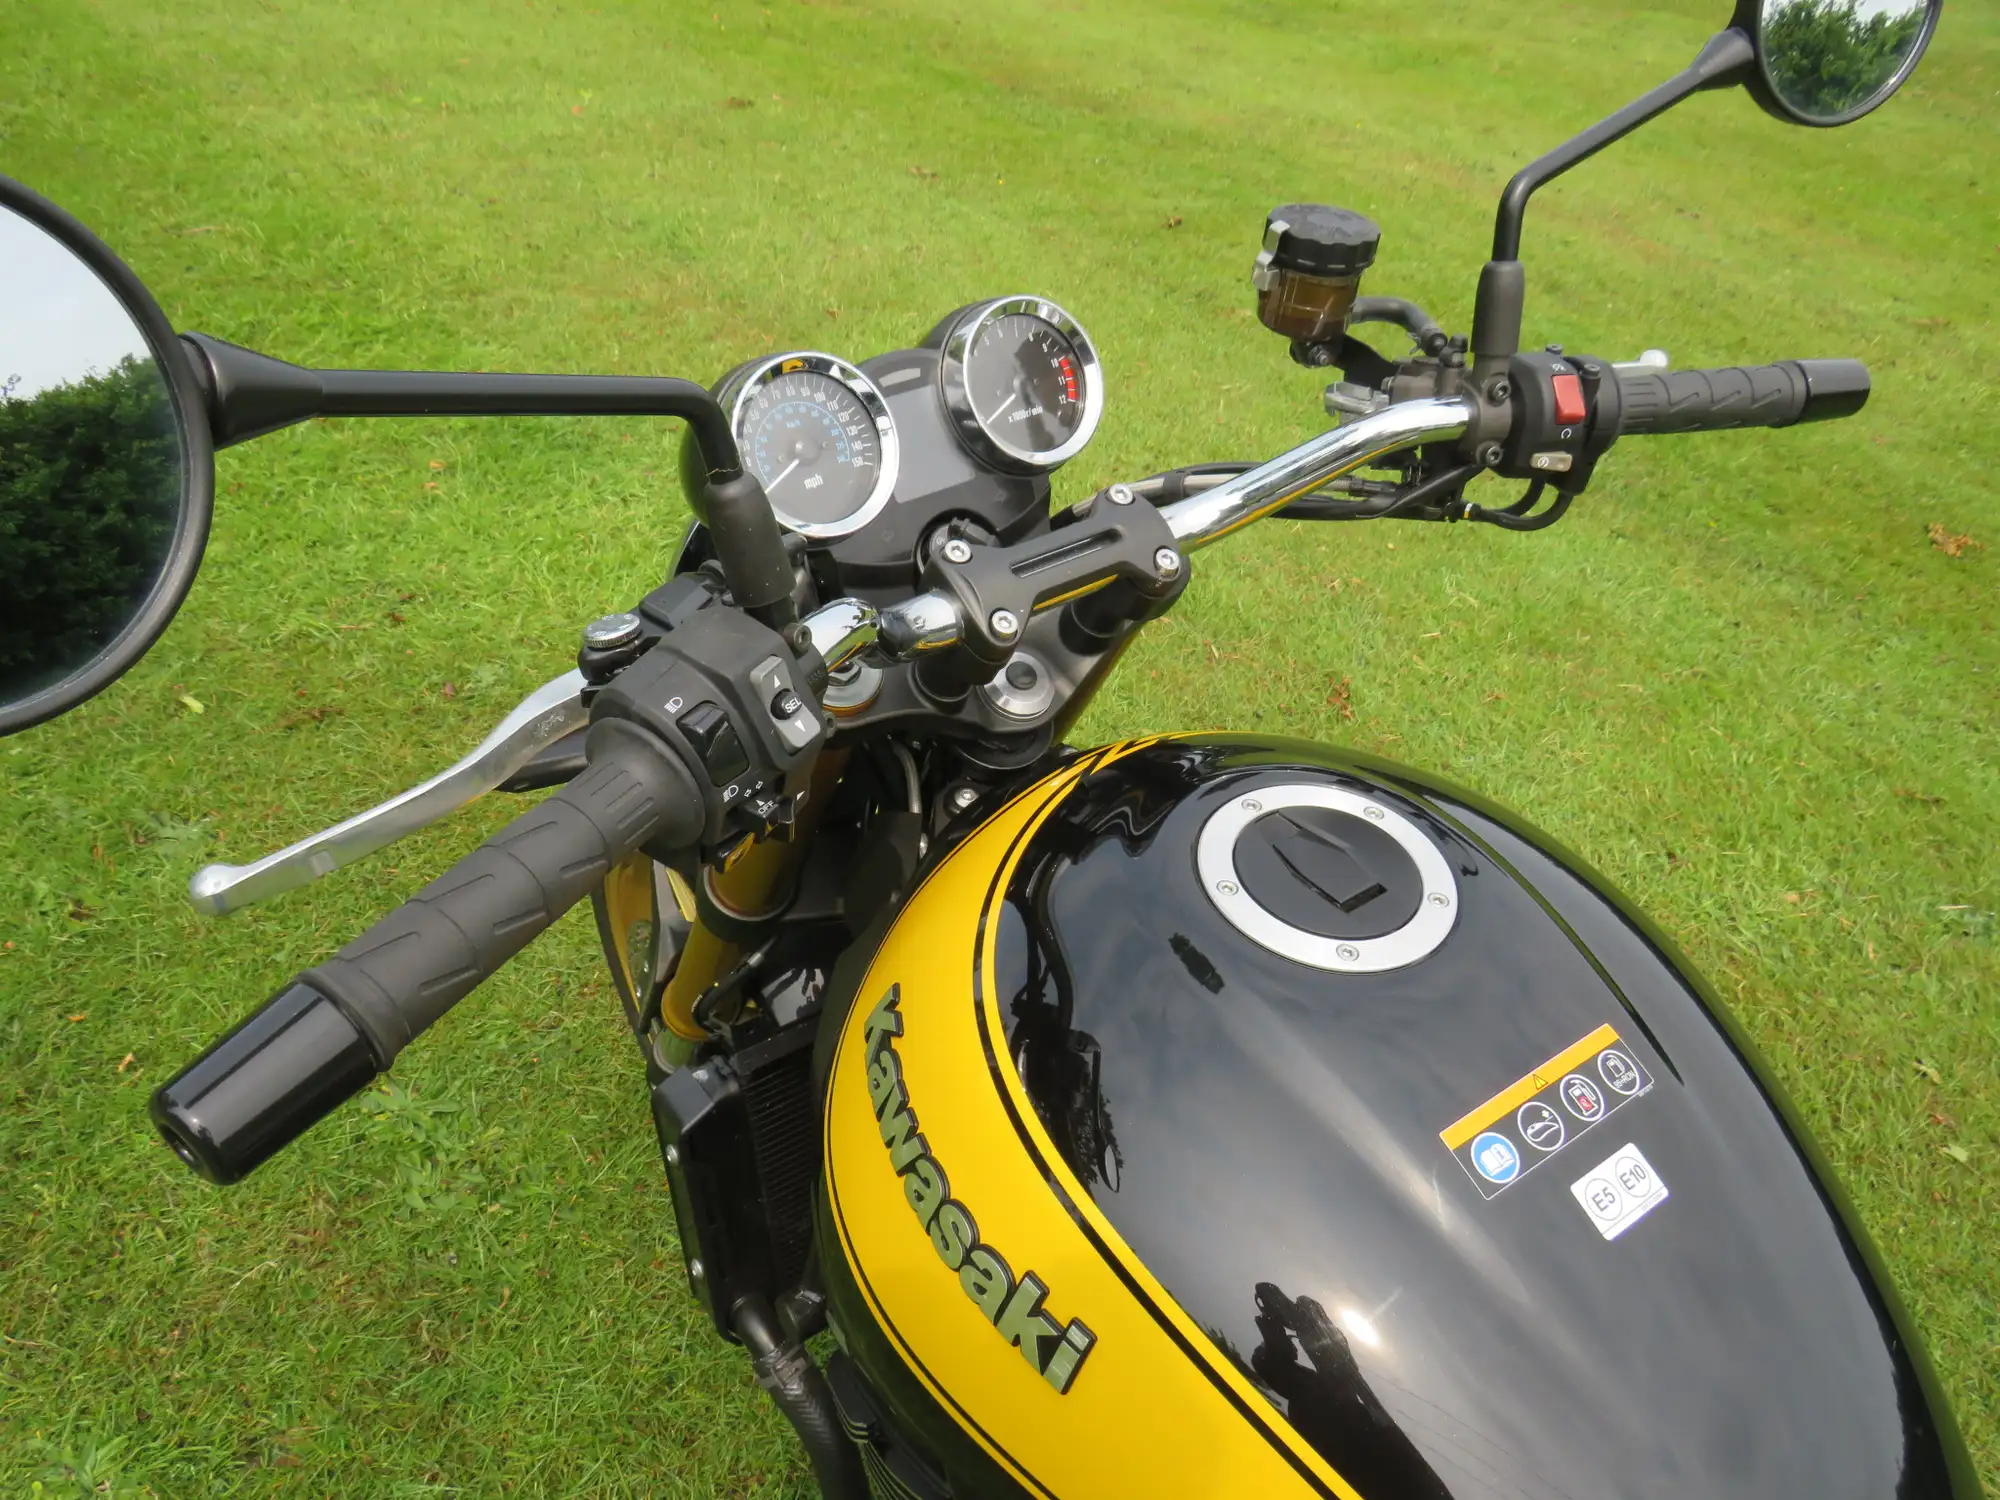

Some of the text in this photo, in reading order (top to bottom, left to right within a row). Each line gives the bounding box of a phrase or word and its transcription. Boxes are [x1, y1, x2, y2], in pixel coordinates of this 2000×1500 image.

[1050, 358, 1059, 369] 10
[1058, 375, 1066, 385] 11
[800, 386, 810, 397] 90
[813, 391, 826, 403] 100
[1058, 394, 1067, 404] 12
[827, 400, 839, 411] 110
[838, 411, 850, 423] 120
[851, 440, 863, 452] 140
[852, 456, 864, 468] 150
[804, 473, 823, 489] mph
[784, 697, 802, 715] SEL
[757, 800, 775, 815] OFF
[1619, 1164, 1646, 1191] E10
[863, 981, 1098, 1396] Kawasaki
[1591, 1186, 1616, 1212] E5
